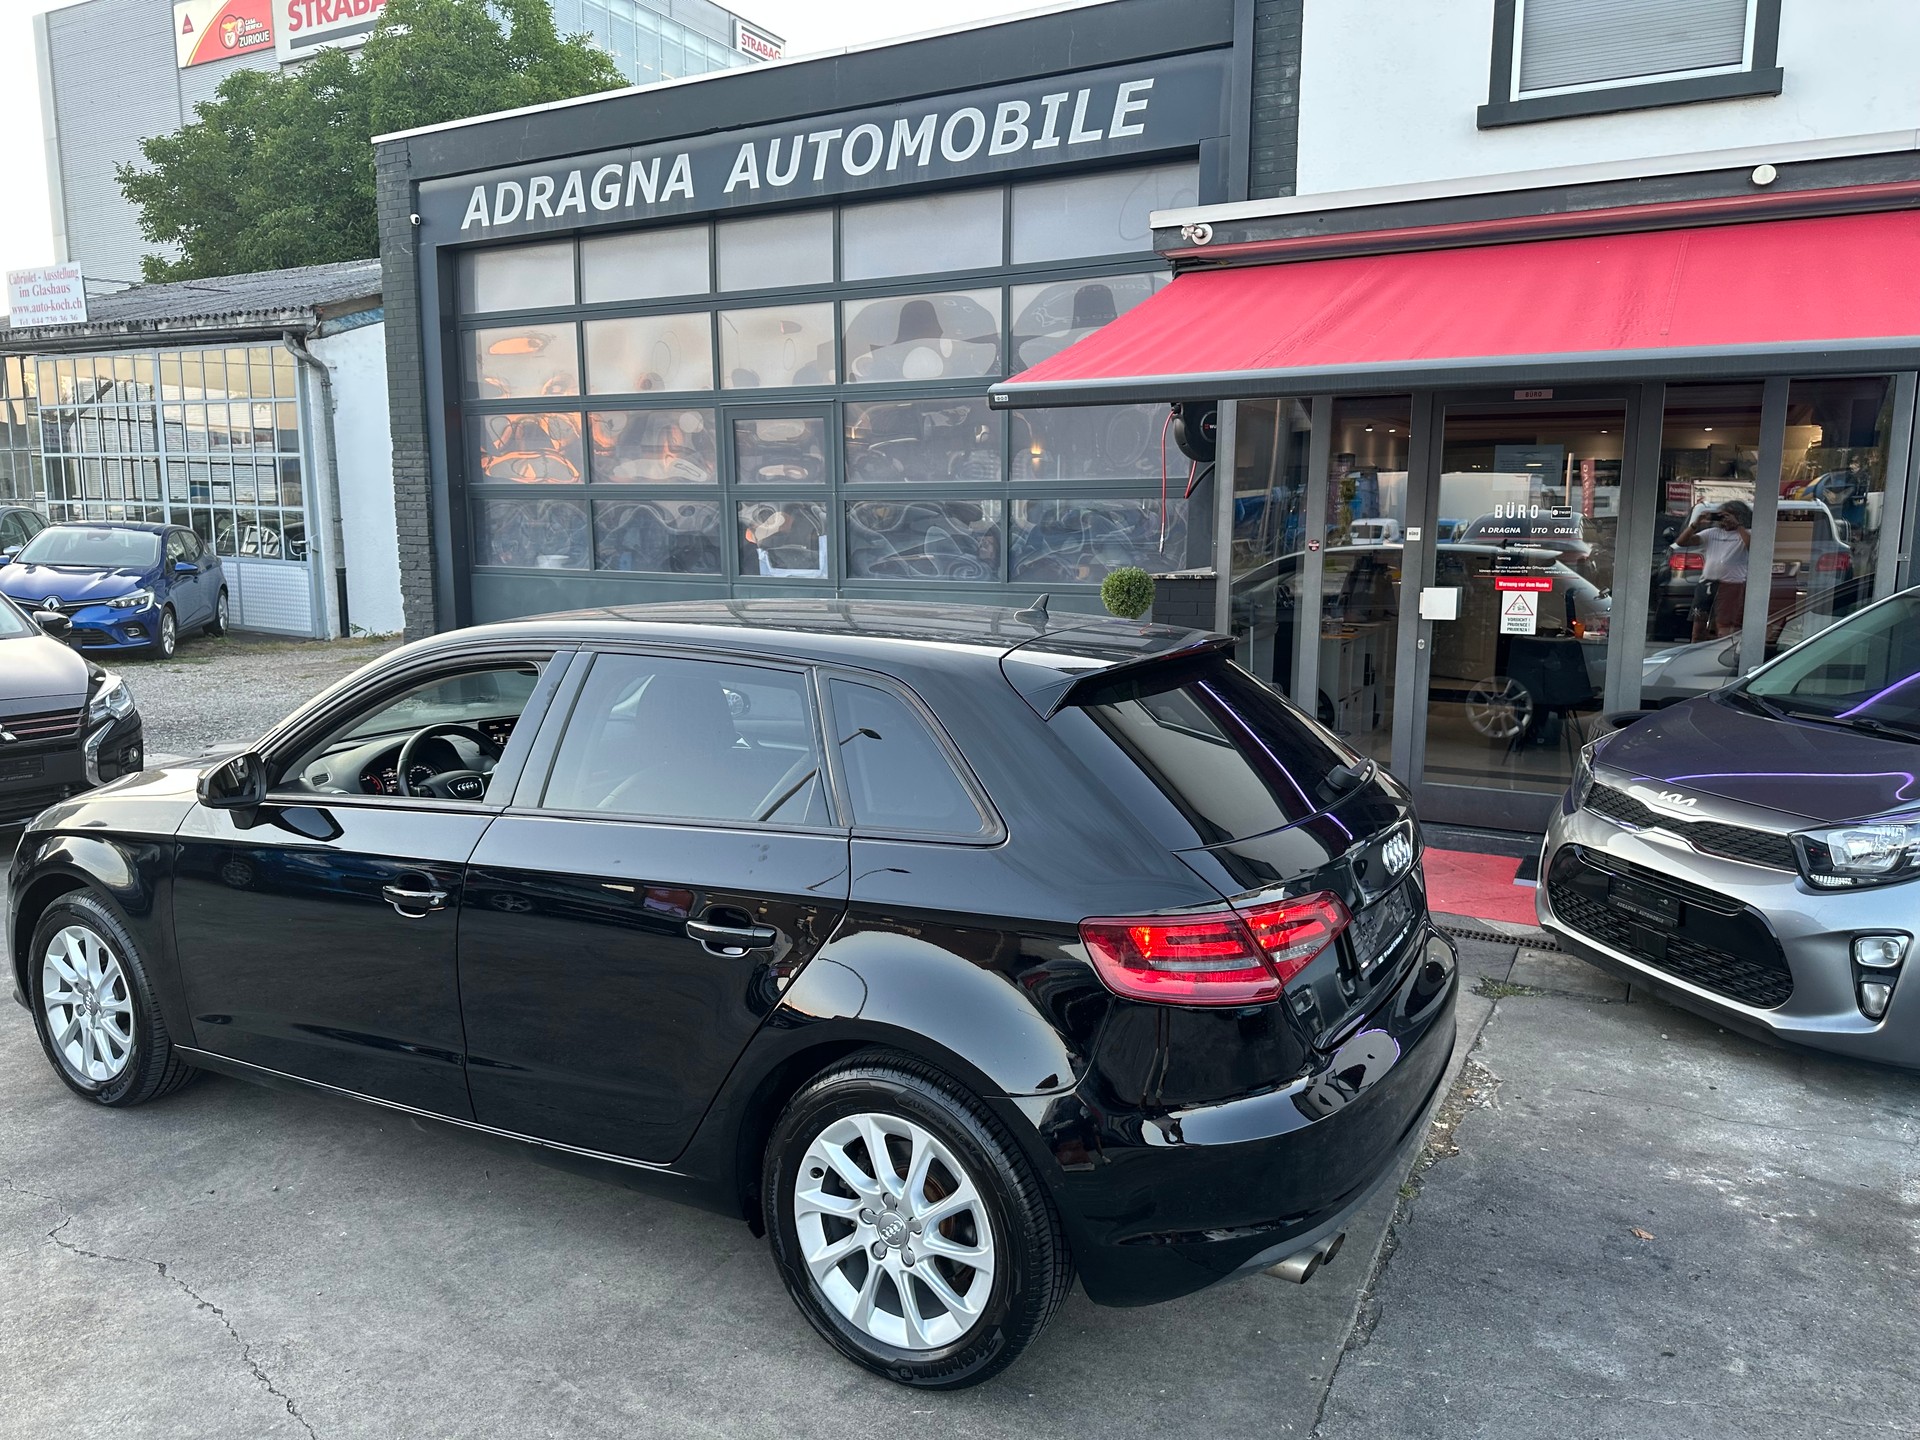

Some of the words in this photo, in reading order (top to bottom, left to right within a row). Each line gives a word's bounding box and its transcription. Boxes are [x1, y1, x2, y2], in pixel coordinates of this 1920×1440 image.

[239, 30, 270, 47] ZURIQUE
[741, 33, 781, 60] STRABAG
[460, 152, 695, 230] ADRAGNA
[723, 78, 1155, 194] AUTOMOBILE
[9, 272, 36, 286] Cabriolet
[44, 268, 80, 281] Ausstellung
[19, 286, 30, 298] im
[32, 283, 71, 296] Glashaus
[12, 297, 83, 314] www.auto-koch.ch
[1494, 502, 1539, 519] BÜRO
[1657, 791, 1697, 807] KIA
